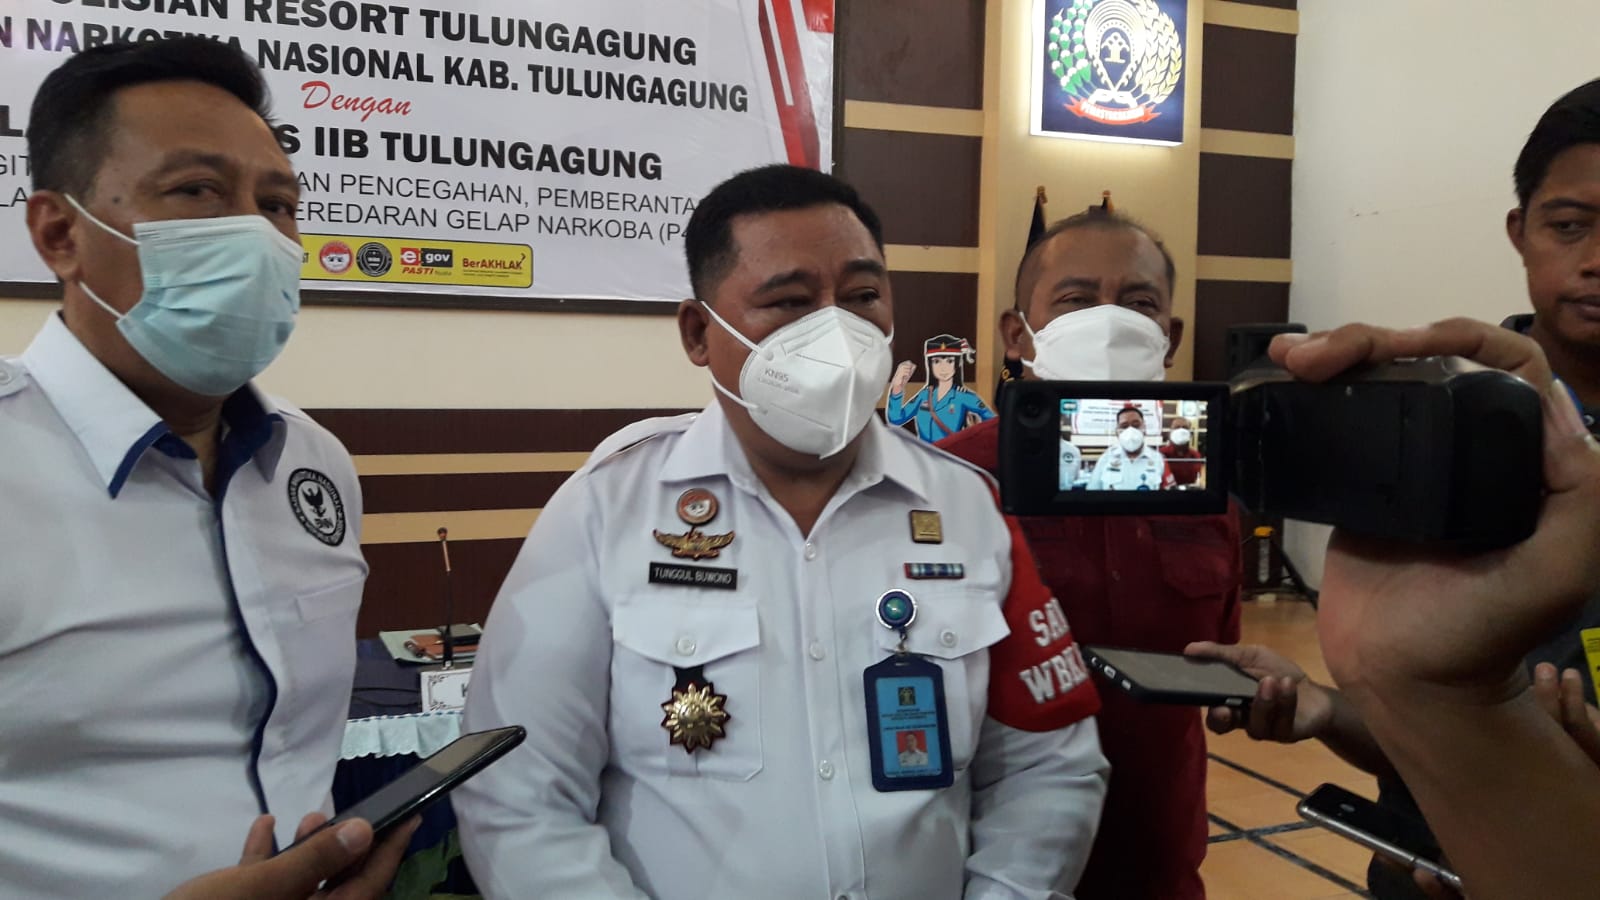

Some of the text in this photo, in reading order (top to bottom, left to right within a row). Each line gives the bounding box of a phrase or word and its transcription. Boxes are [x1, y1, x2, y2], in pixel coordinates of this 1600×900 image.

[244, 0, 409, 36] RESORT
[419, 8, 697, 66] TULUNGAGUNG
[258, 38, 434, 83] NASIONAL
[444, 55, 519, 91] KAB.
[527, 63, 749, 113] TULUNGAGUNG
[300, 80, 412, 122] Dengan
[314, 126, 369, 159] IIB
[380, 130, 663, 181] TULUNGAGUNG
[340, 174, 529, 208] PENCEGAHAN,
[446, 209, 530, 233] GELAP
[537, 215, 654, 241] NARKOBA
[402, 266, 434, 275] PASTI
[425, 253, 451, 264] gov
